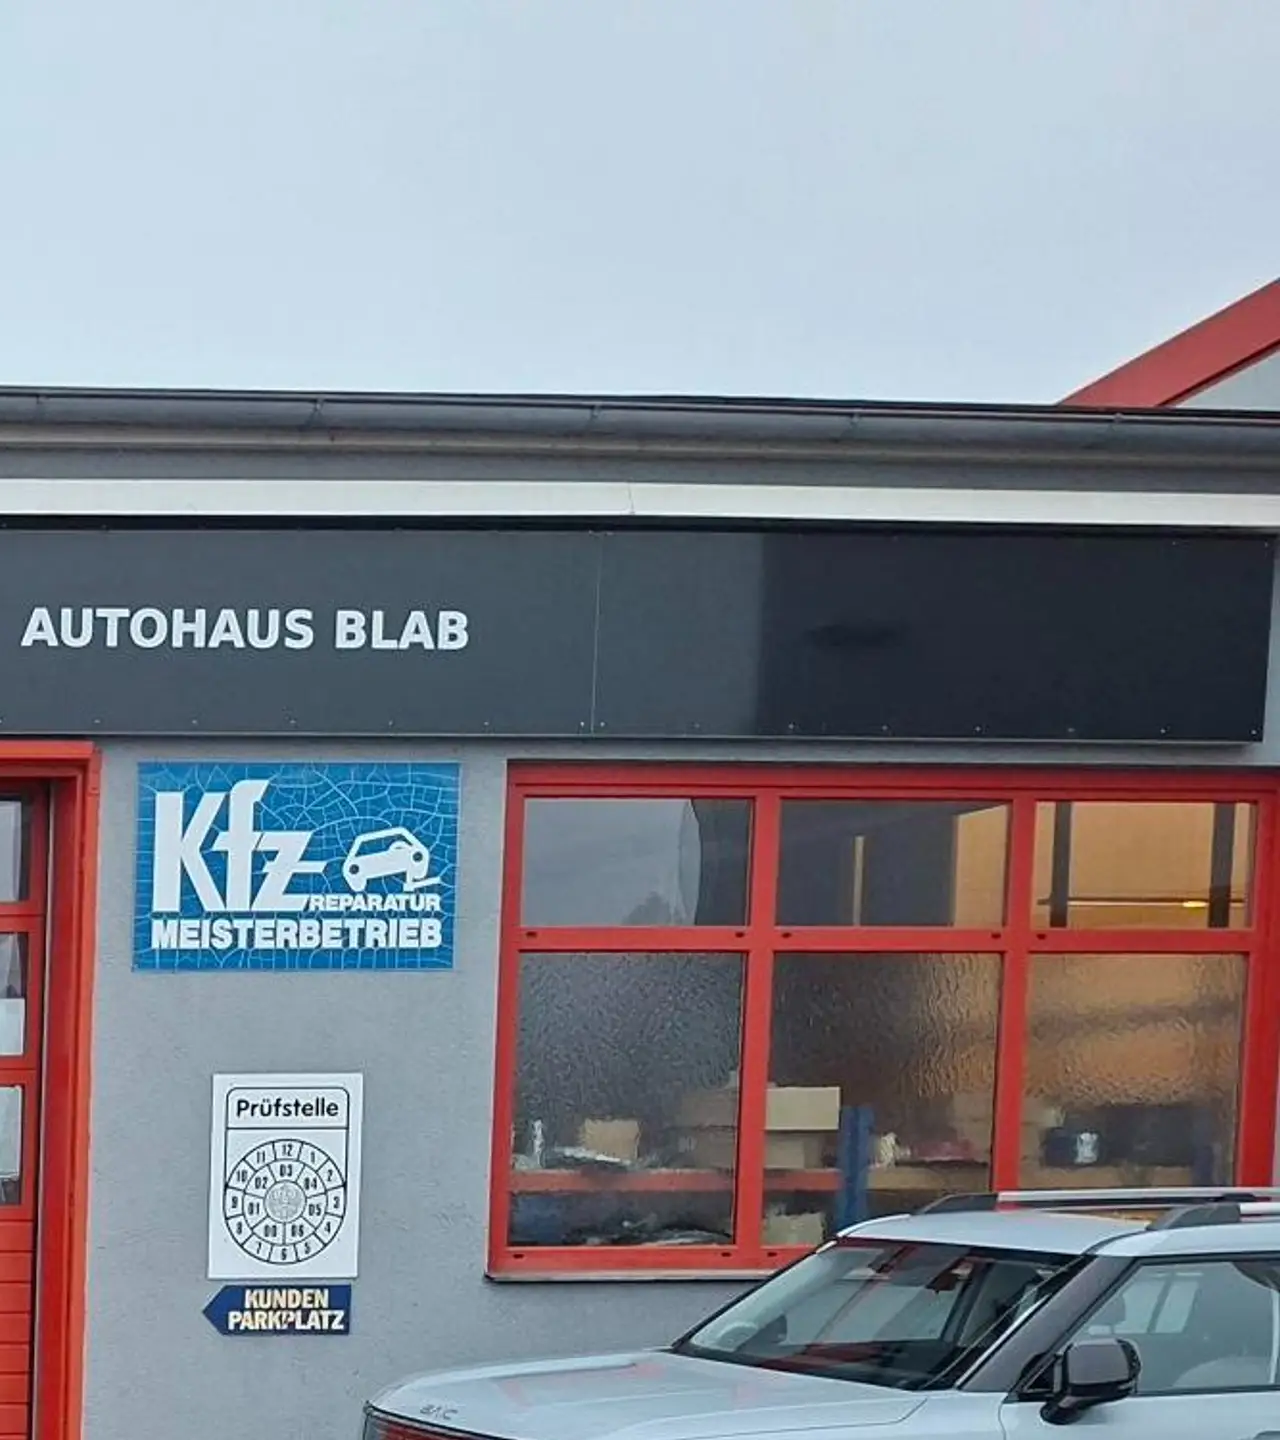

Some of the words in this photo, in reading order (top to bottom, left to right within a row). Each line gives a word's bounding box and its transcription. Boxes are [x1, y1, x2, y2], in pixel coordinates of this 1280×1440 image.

[21, 608, 315, 650] AUTOHAUS
[335, 610, 469, 650] BLAB
[152, 779, 327, 912] Kfz
[308, 893, 441, 911] REPARATUR
[151, 918, 442, 949] MEISTERBETRIEB
[237, 1096, 339, 1118] Prüfstelle
[282, 1144, 292, 1156] 12
[257, 1151, 265, 1164] 11
[311, 1151, 315, 1163] 1
[237, 1170, 248, 1182] 10
[280, 1164, 292, 1177] 03
[327, 1169, 333, 1181] 2
[255, 1177, 268, 1189] 02
[304, 1178, 317, 1190] 04
[248, 1202, 259, 1215] 01
[309, 1204, 321, 1216] 05
[244, 1288, 329, 1309] KUNDEN
[227, 1310, 345, 1330] PARKPLATZ
